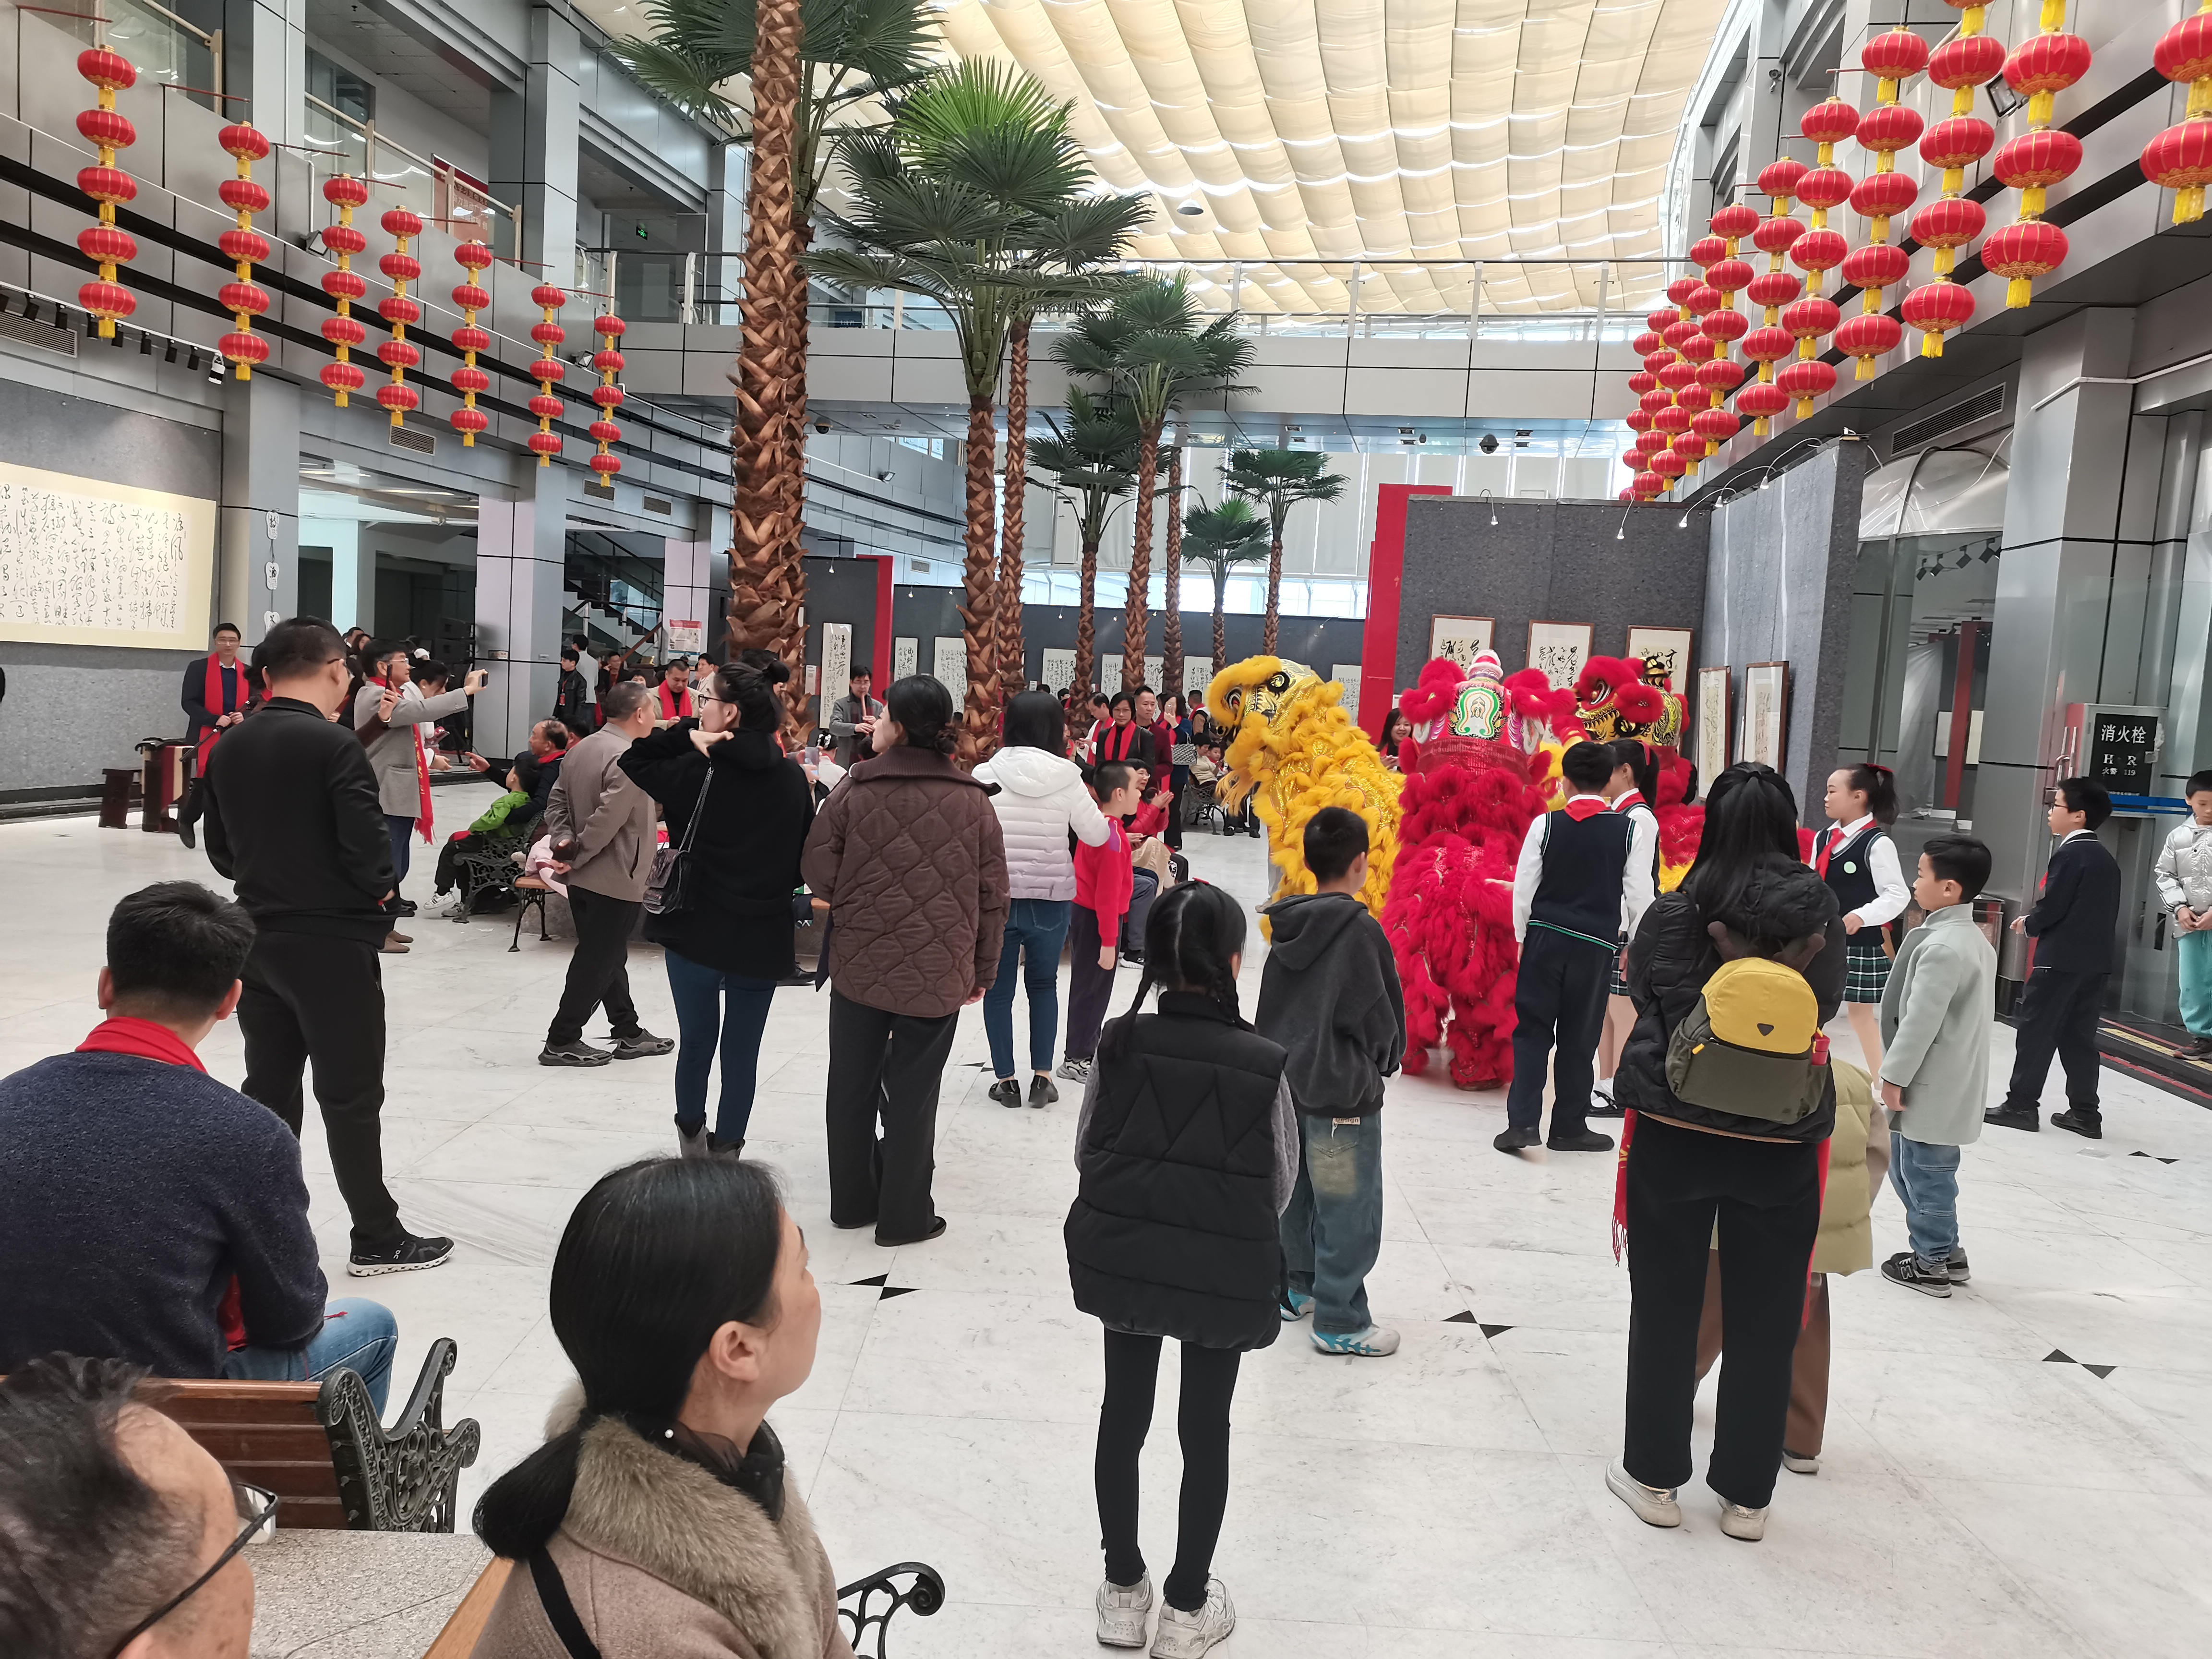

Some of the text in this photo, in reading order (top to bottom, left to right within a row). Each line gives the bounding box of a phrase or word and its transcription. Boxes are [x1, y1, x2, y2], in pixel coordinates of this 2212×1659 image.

[2101, 723, 2147, 744] 消火栓
[2101, 767, 2118, 775] 火警
